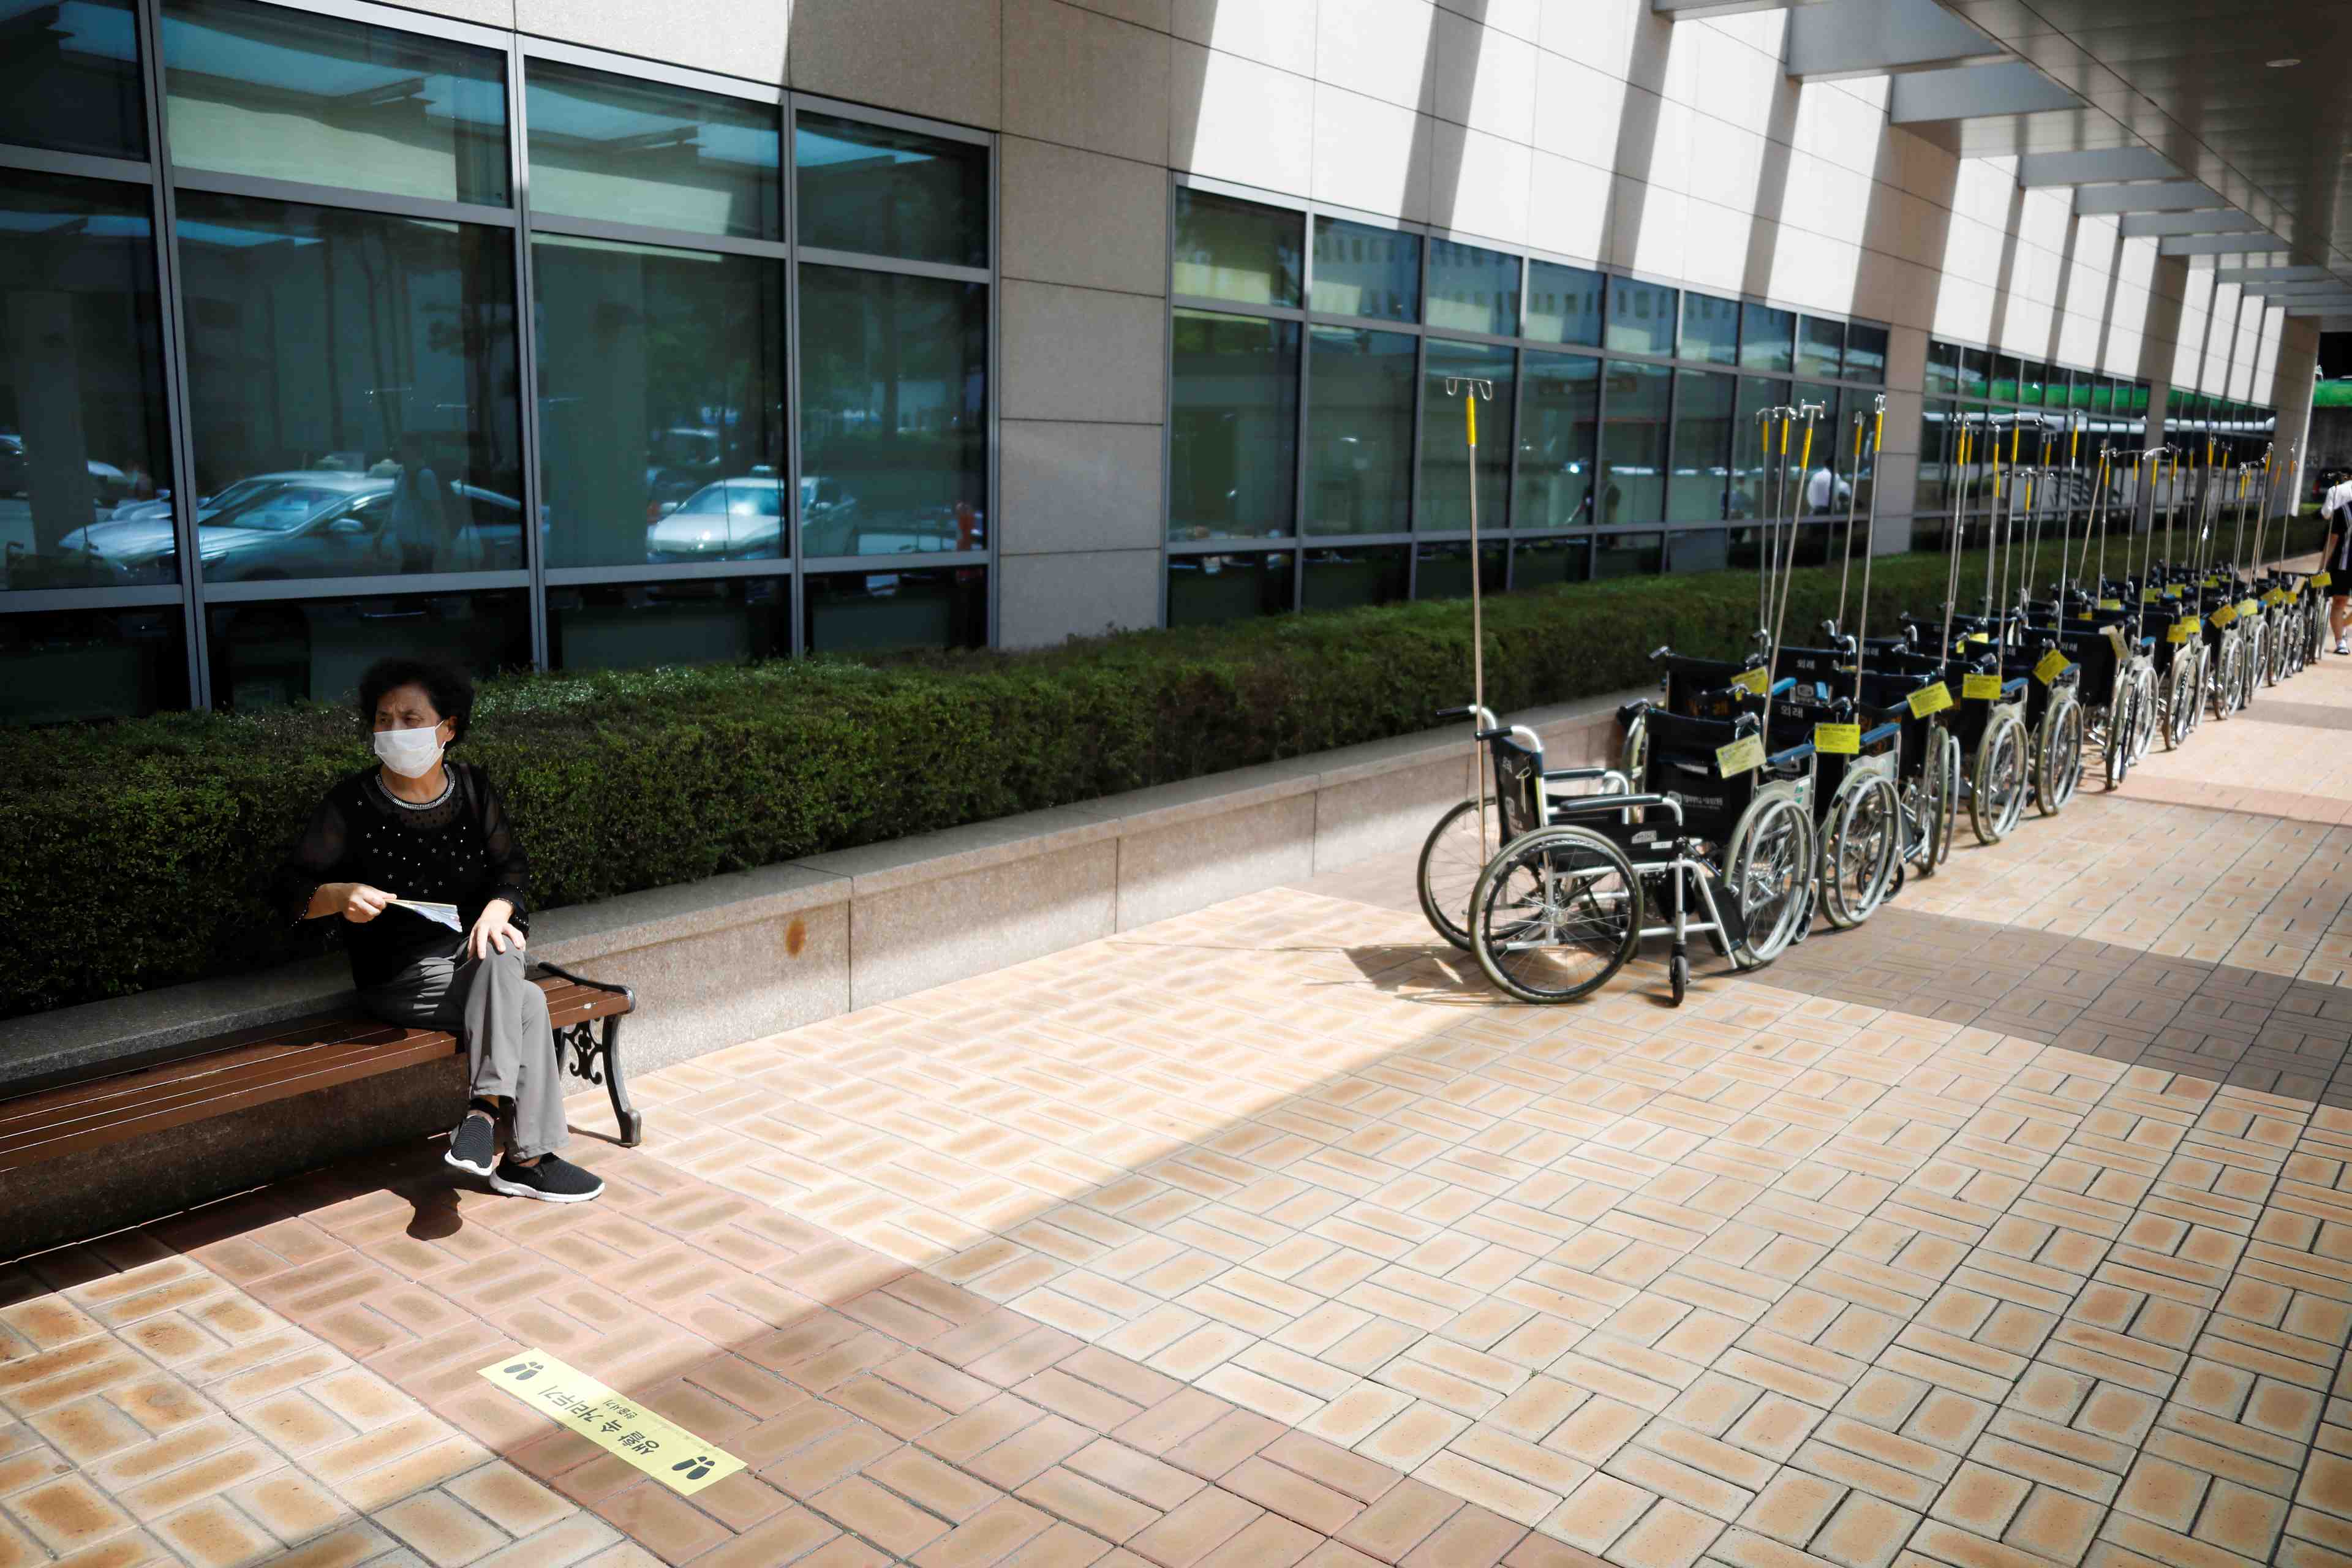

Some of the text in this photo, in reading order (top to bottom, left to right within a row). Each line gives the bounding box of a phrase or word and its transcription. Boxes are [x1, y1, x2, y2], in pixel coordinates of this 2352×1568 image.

[1781, 705, 1803, 719] 외래
[537, 1385, 660, 1455] 생활 속 거리두기
[602, 1400, 638, 1420] 한줄서기
